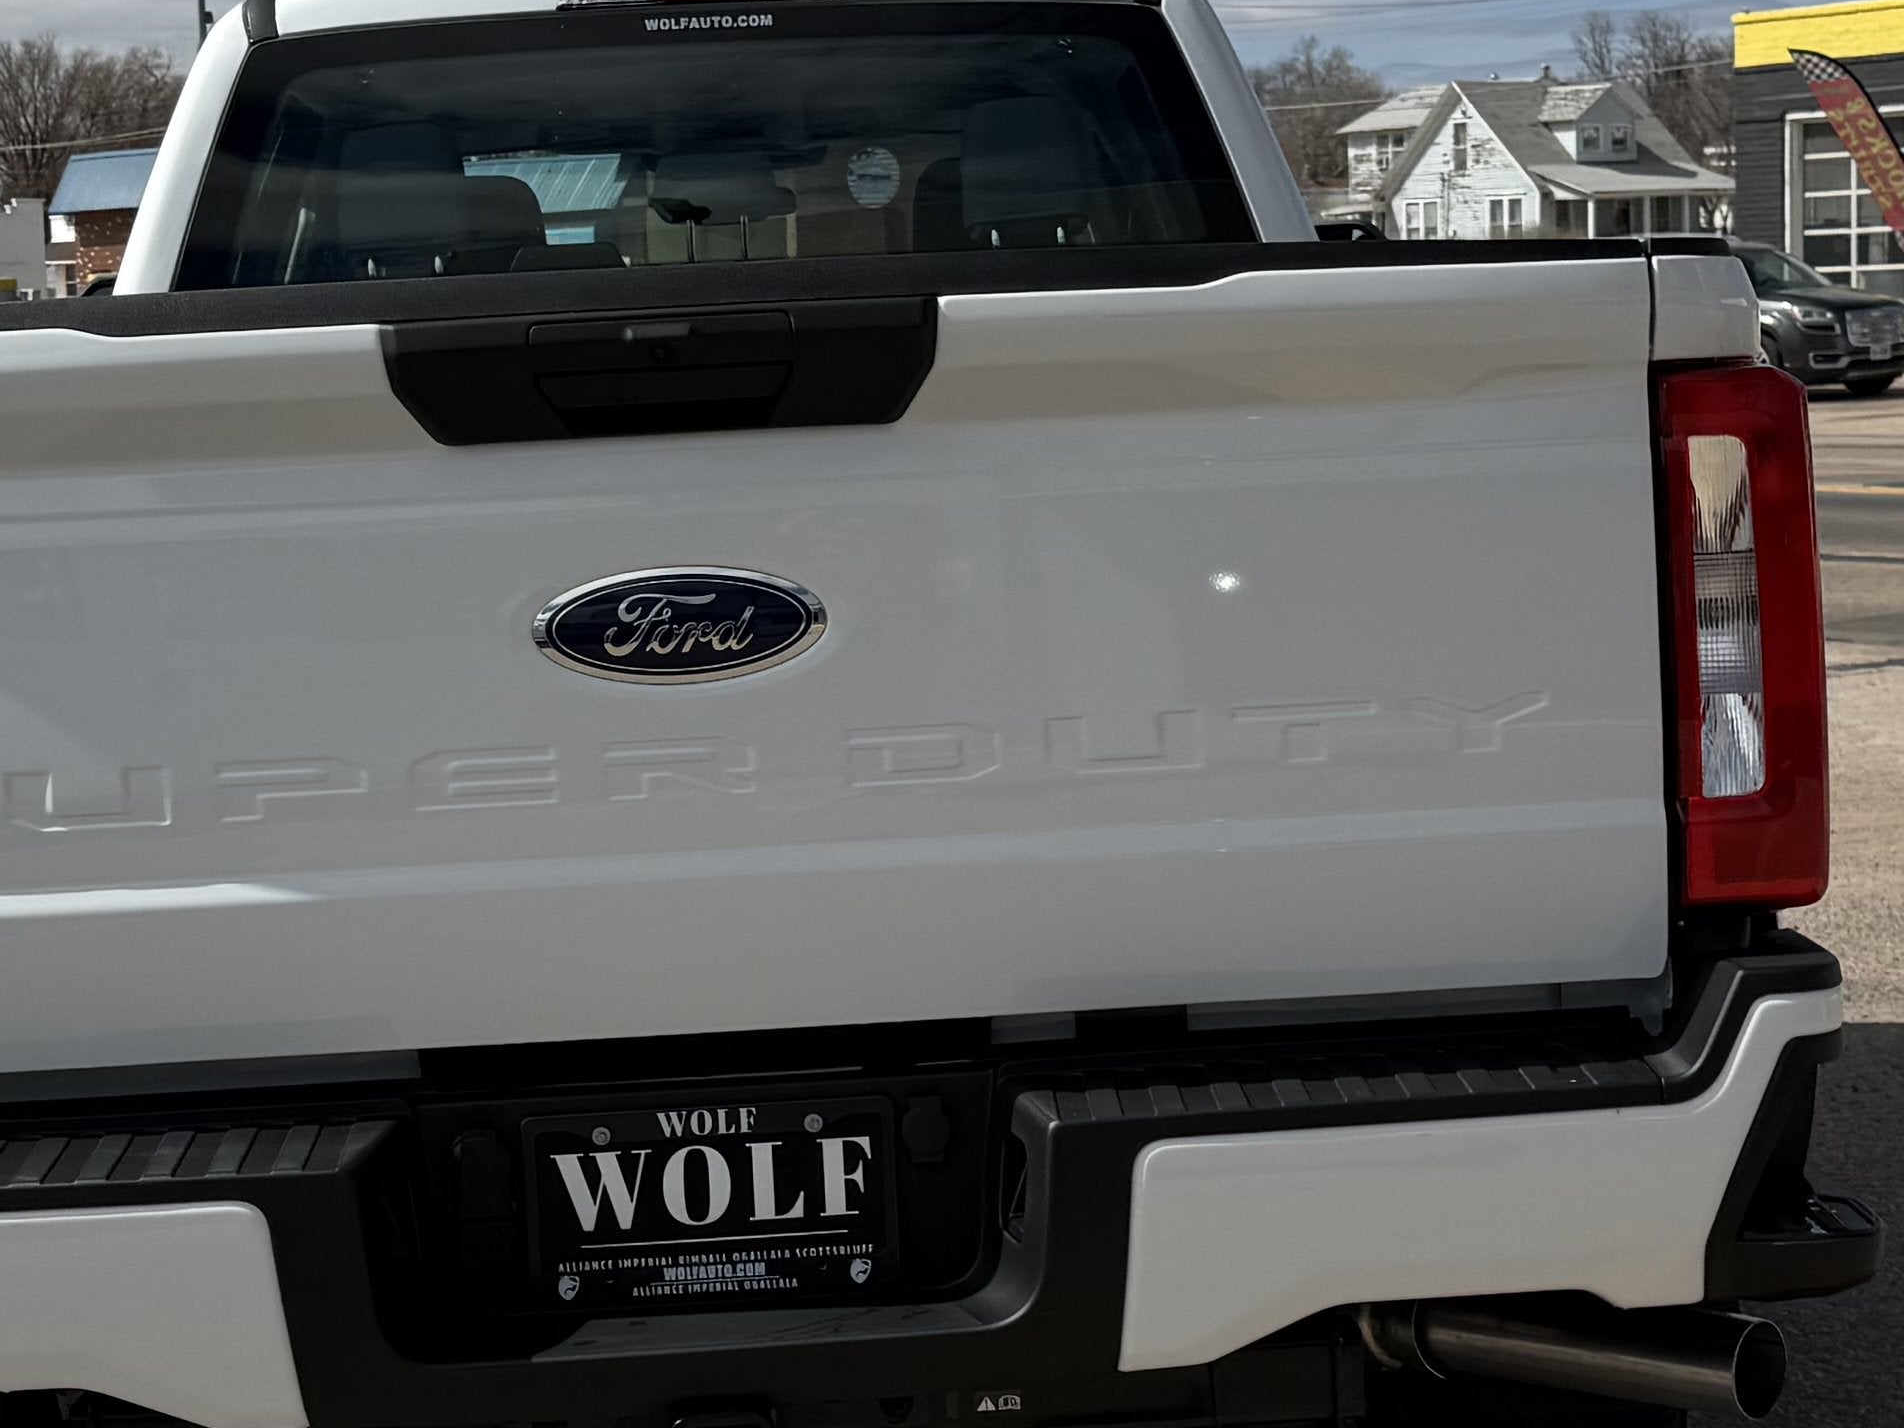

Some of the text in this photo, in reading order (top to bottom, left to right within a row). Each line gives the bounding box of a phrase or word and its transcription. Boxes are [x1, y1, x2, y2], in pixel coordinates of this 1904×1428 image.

[644, 13, 774, 32] WOLFAUTO.COM
[603, 592, 754, 658] Ford
[845, 689, 1550, 790] DUTY
[656, 1106, 757, 1139] WOLF
[549, 1135, 873, 1233] WOLF
[558, 1259, 614, 1273] ALLIANCE
[618, 1256, 673, 1269] IMPERIAL
[663, 1262, 766, 1281] WOLFAUTO.COM
[632, 1283, 684, 1297] ALLIANCE
[688, 1280, 740, 1294] IMPERIAL
